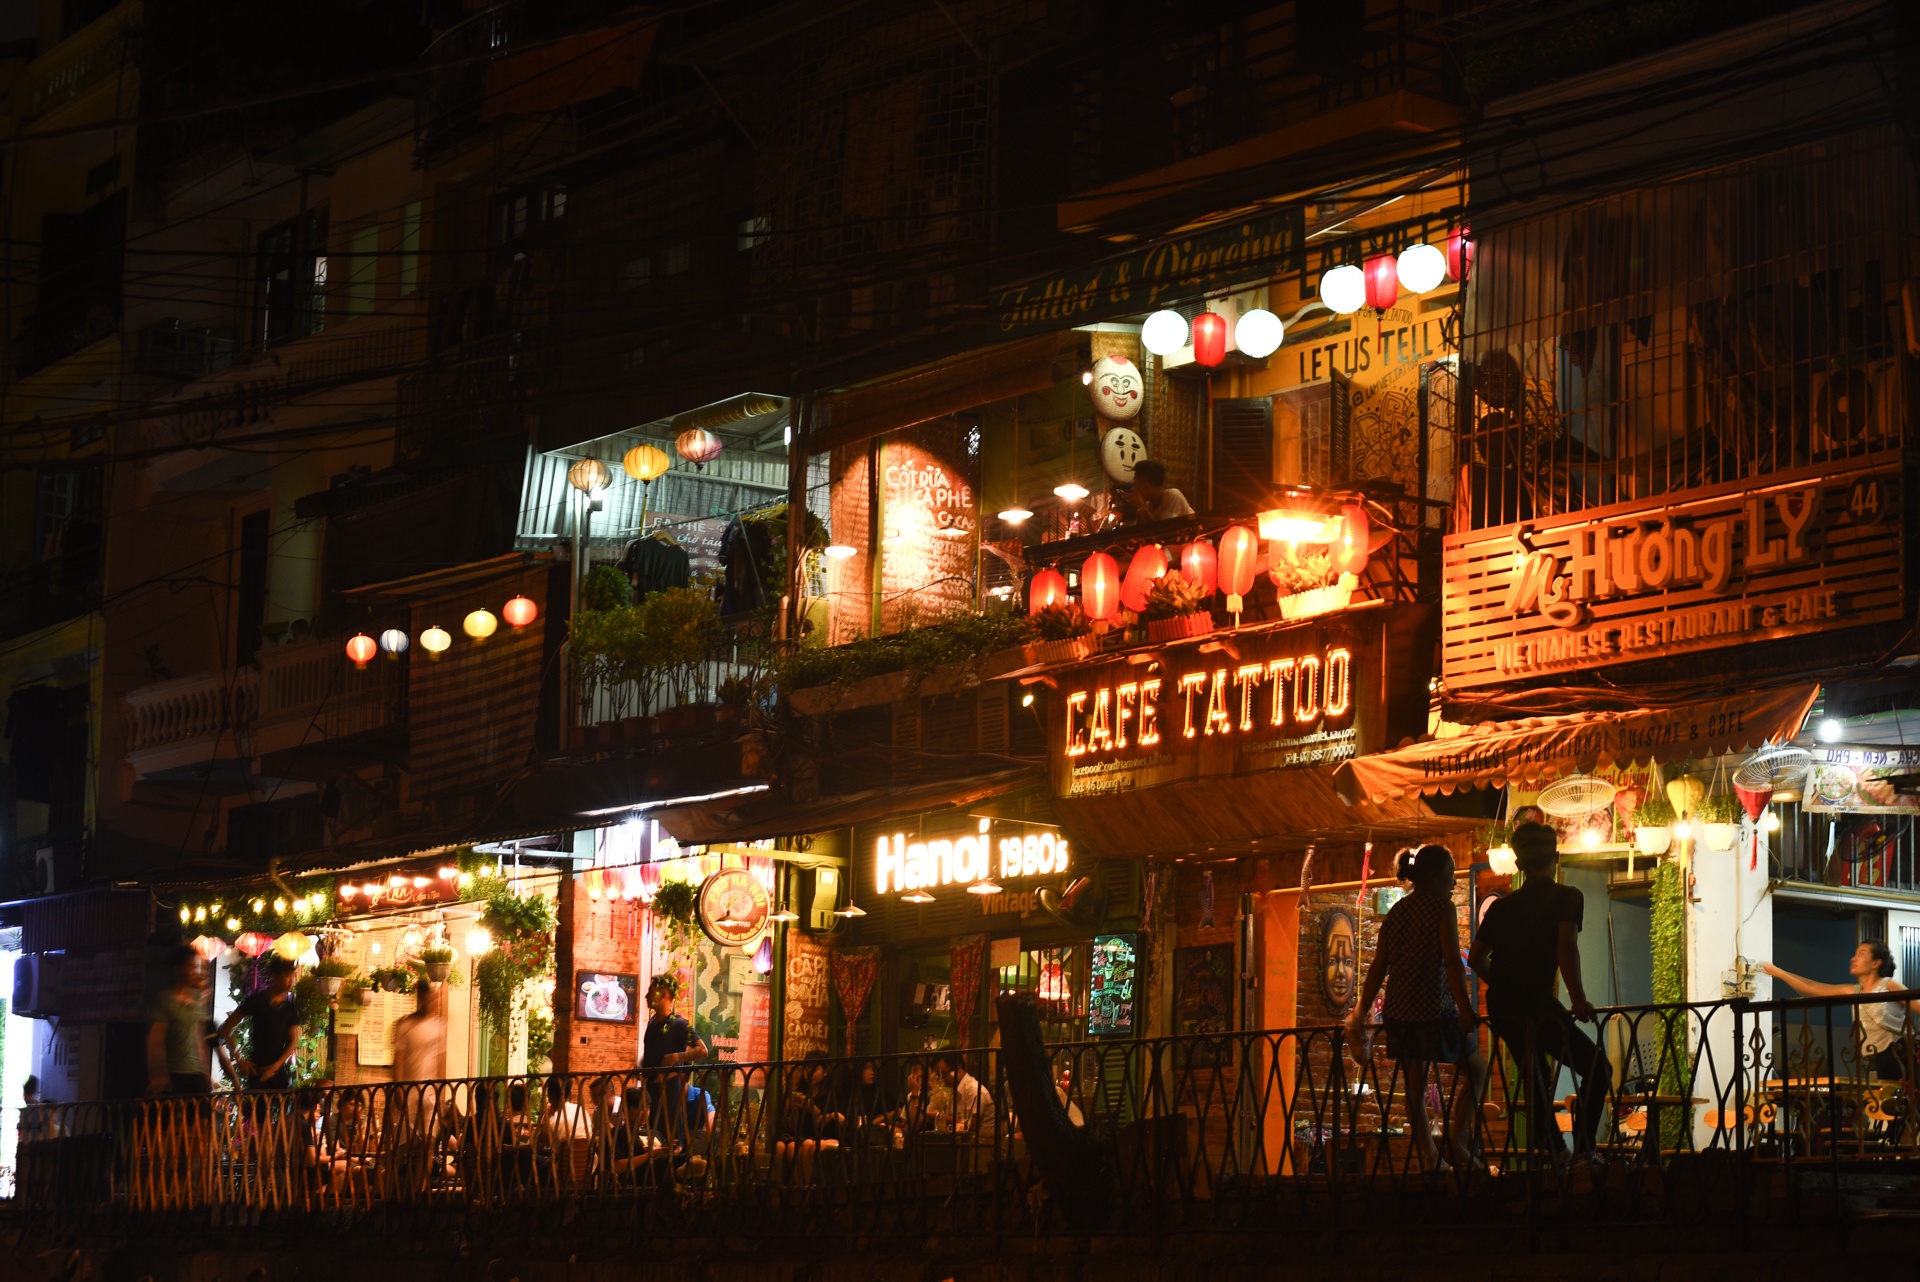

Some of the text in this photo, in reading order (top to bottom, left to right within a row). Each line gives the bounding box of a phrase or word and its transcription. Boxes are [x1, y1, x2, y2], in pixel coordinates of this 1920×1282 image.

[1000, 224, 1293, 332] Tattoo & Piercing
[1301, 346, 1338, 383] LET
[1345, 335, 1370, 373] US
[1381, 321, 1433, 366] TELL
[1745, 488, 1817, 568] LY
[1851, 481, 1878, 516] 44
[1493, 590, 1837, 671] VIETNAMESE RESTAURANT & CAFE
[1064, 647, 1351, 757] CAFÉ TATTOO
[1423, 745, 1508, 777] VIETNAMESE
[1619, 720, 1680, 750] CUISINE
[1689, 723, 1698, 737] &
[876, 818, 1069, 895] Hanoi 1980s
[981, 890, 1038, 919] Vintage
